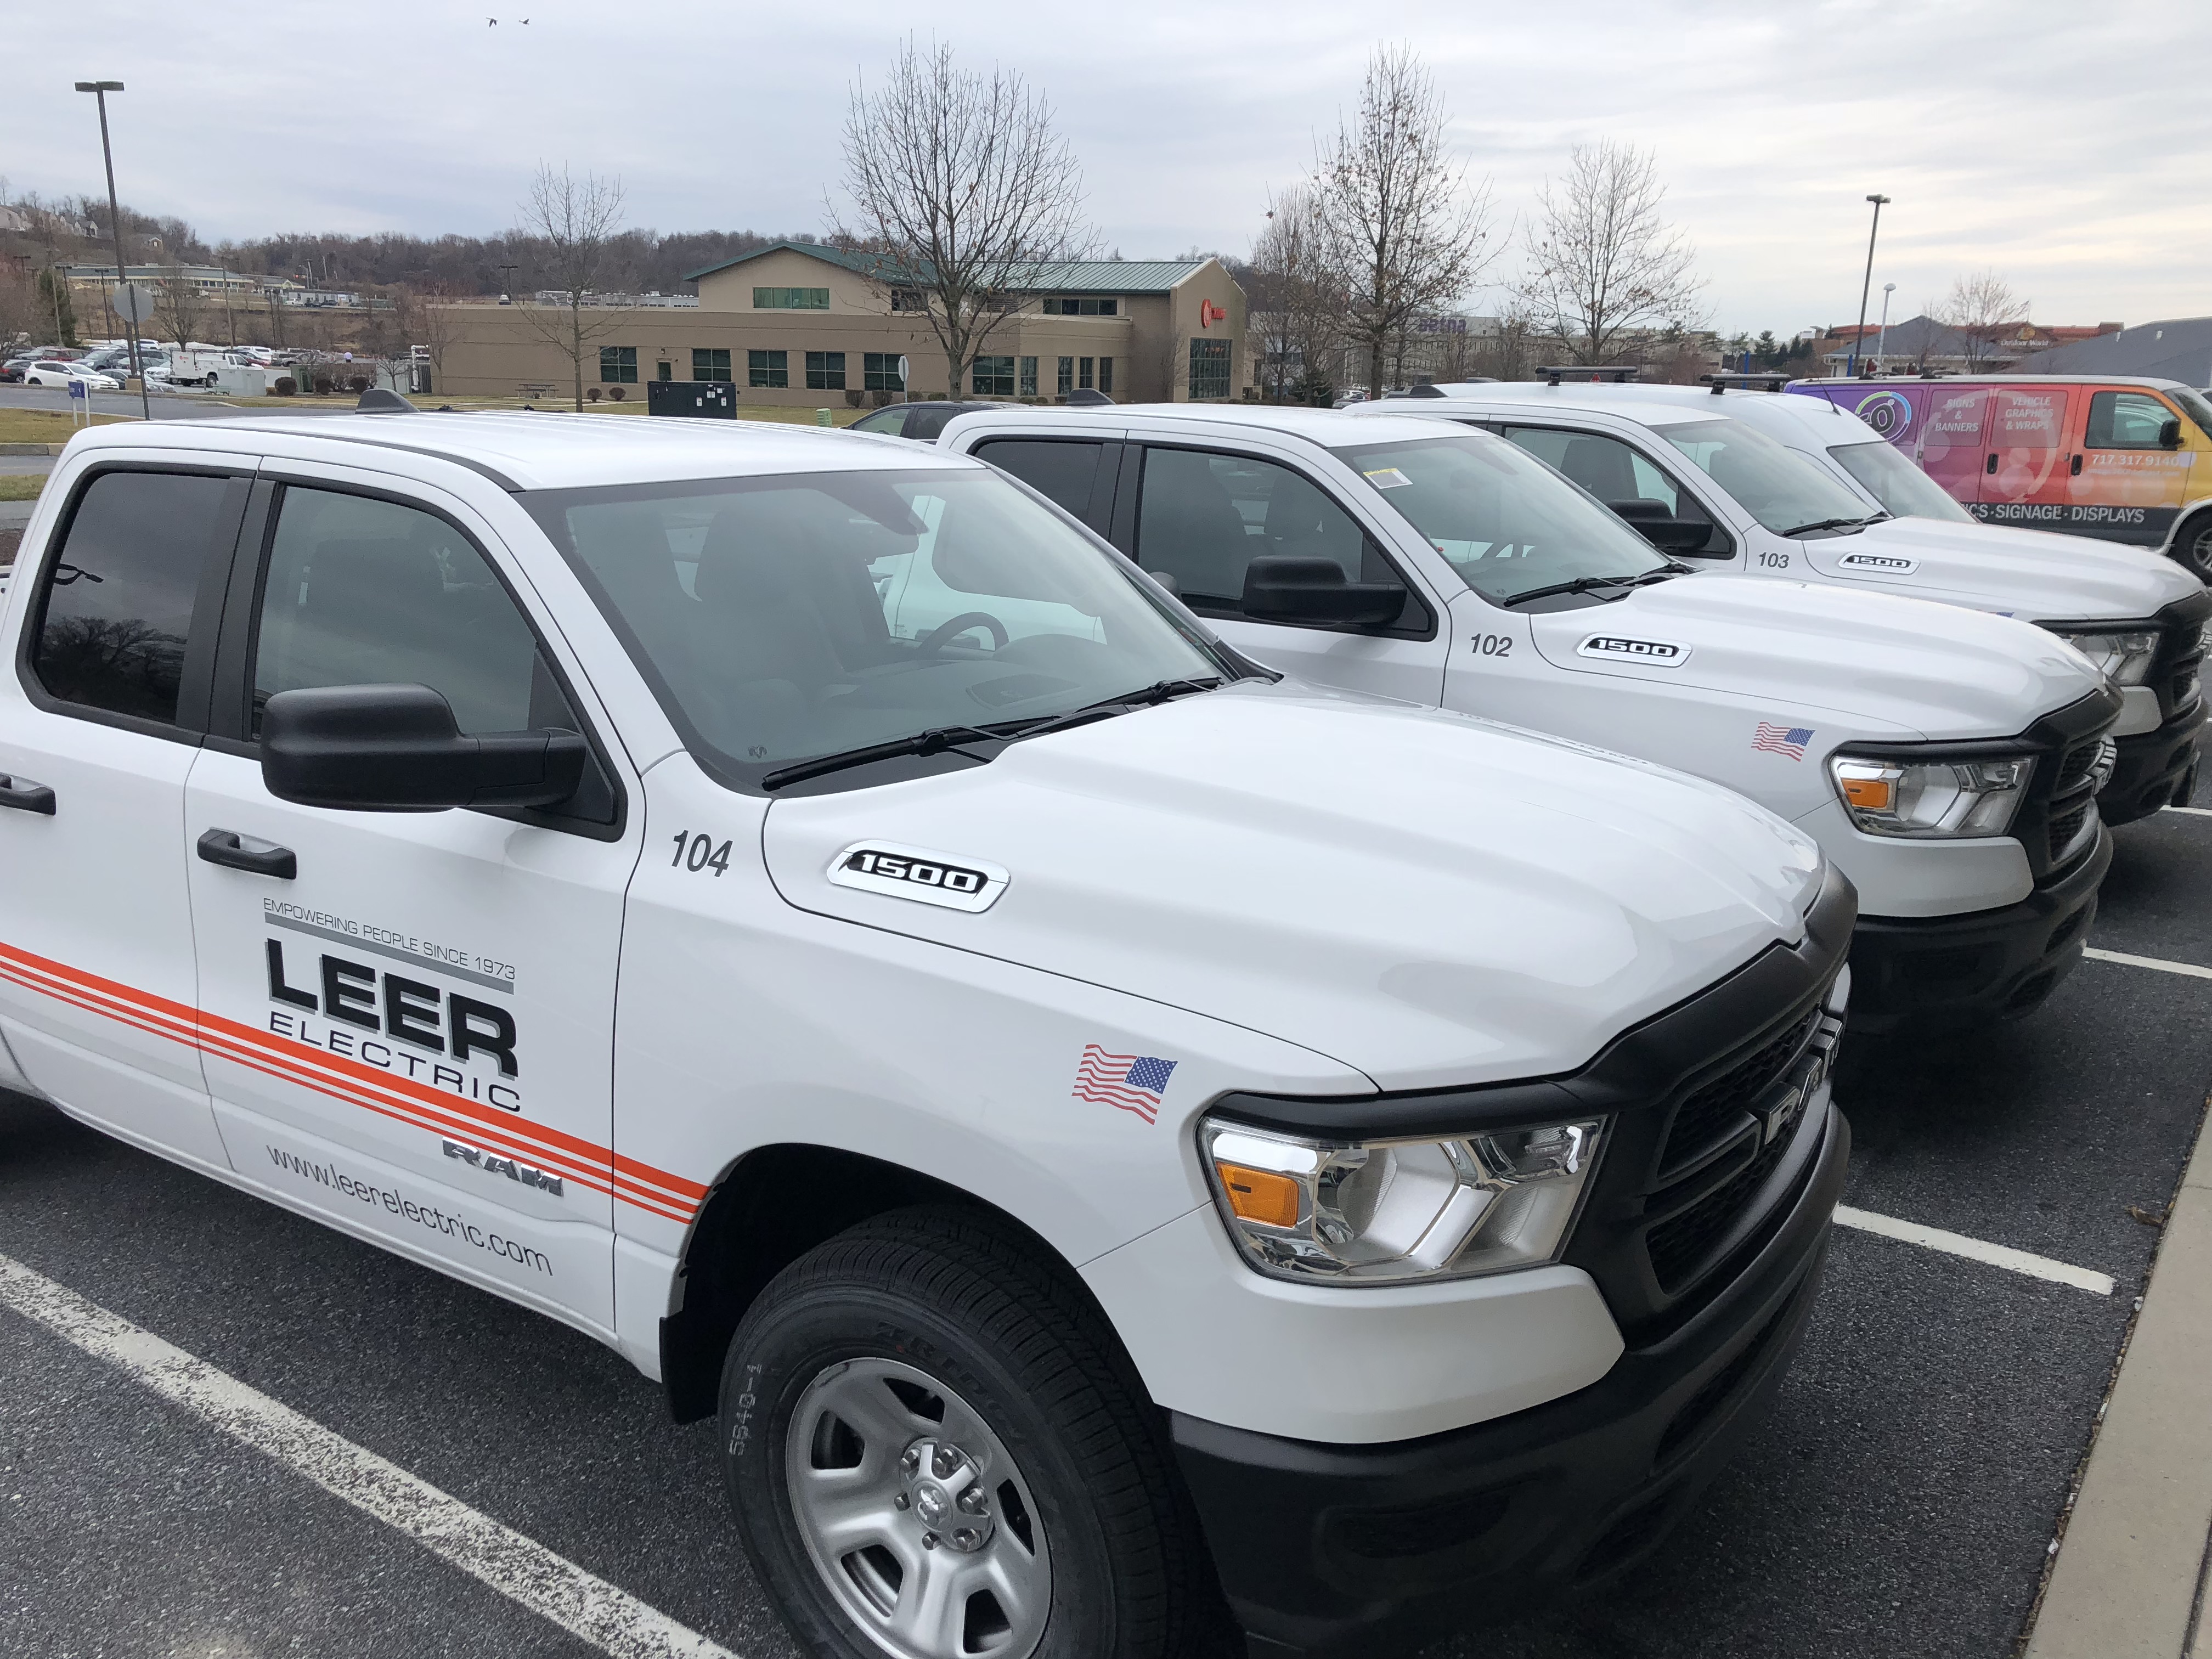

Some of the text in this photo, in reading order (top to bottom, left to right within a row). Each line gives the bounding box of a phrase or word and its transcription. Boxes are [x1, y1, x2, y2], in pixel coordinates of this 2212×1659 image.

[1947, 399, 1975, 408] SIGNS
[2012, 397, 2052, 405] VEHICLE
[2006, 408, 2054, 417] GRAPHICS
[1935, 422, 1978, 432] BANNERS
[2016, 420, 2050, 430] WRAPS
[1995, 504, 2062, 520] SIGNAGE
[2072, 507, 2145, 523] DISPLAYS
[1758, 552, 1790, 568] 103
[1853, 556, 1908, 568] 1500
[1471, 633, 1513, 657] 102
[1596, 639, 1675, 657] 1500
[672, 830, 733, 877] 104
[861, 853, 980, 893] 1500
[263, 898, 516, 980] EMPOWERING PEOPLE SINCE 1973
[264, 938, 519, 1081] LEER
[269, 1011, 521, 1113] ELECTRIC
[442, 1136, 564, 1197] RAM
[266, 1145, 553, 1276] www.leerelectric.com
